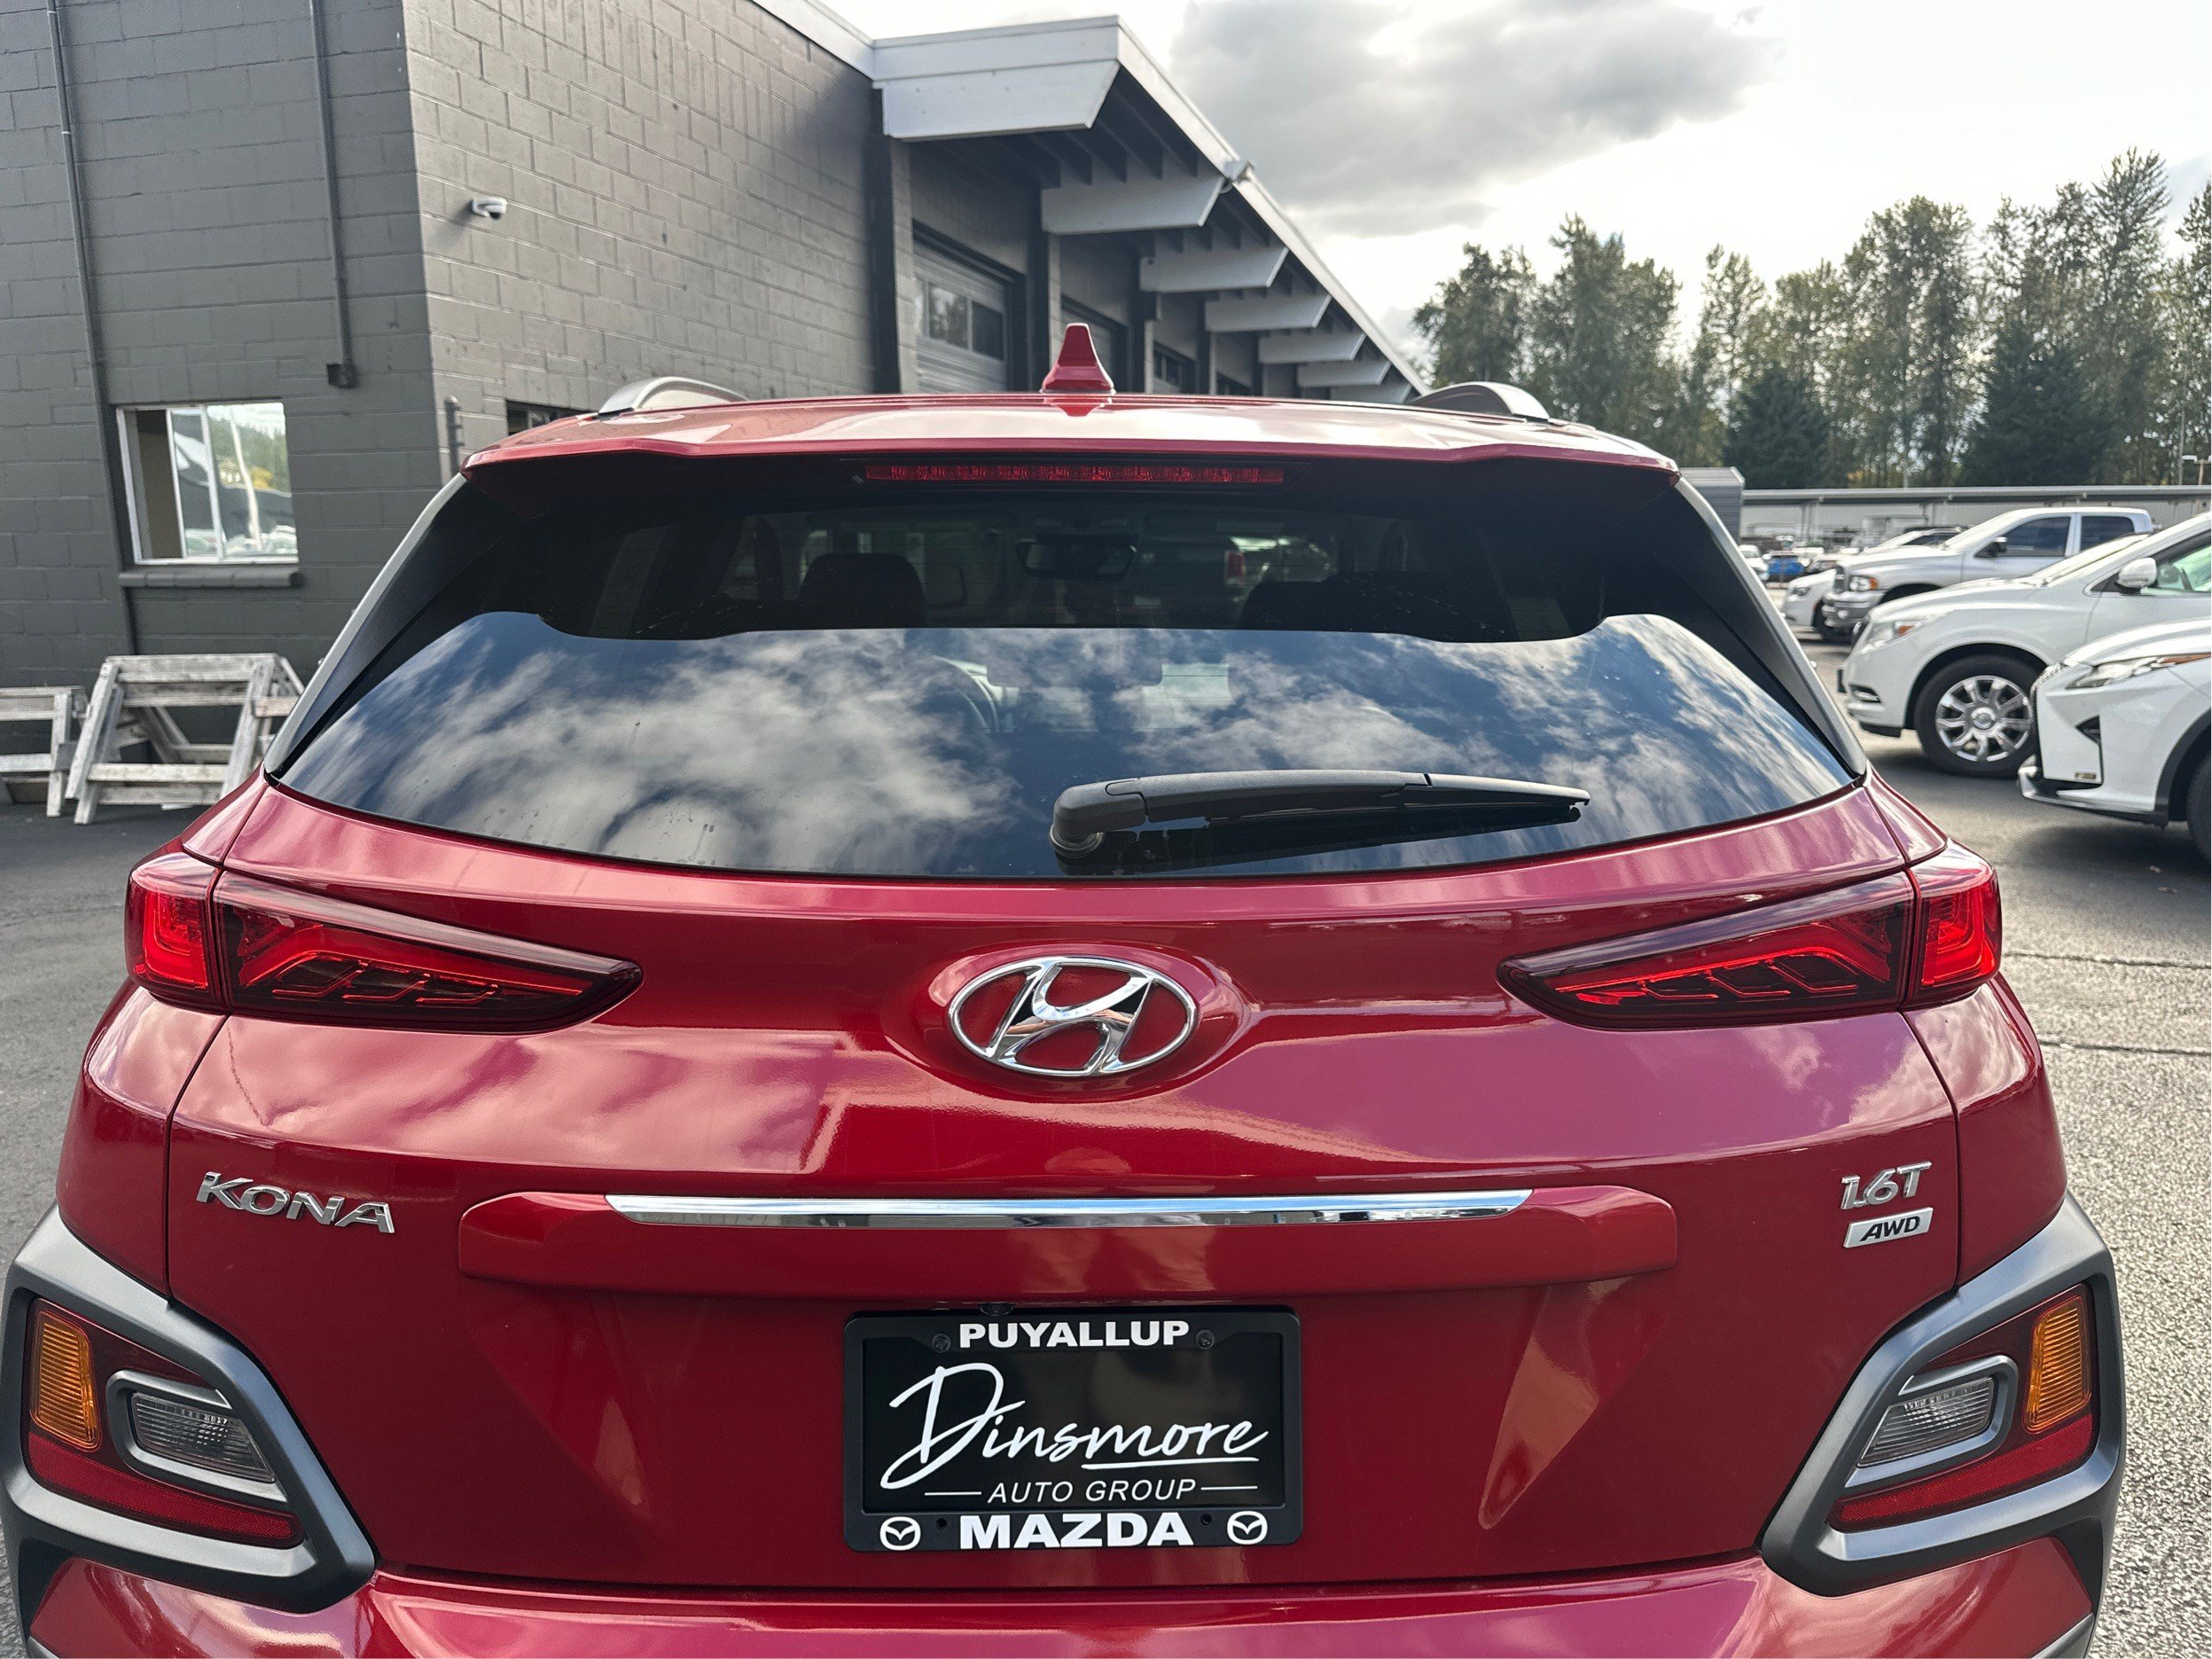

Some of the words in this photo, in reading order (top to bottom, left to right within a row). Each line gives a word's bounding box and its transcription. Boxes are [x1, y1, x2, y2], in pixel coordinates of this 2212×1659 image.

[196, 1170, 395, 1233] KONA
[1859, 1216, 1921, 1241] AWD
[958, 1320, 1191, 1349] PUYALLUP
[879, 1362, 1269, 1489] Dinsmore
[987, 1481, 1073, 1504] AUTO
[1084, 1478, 1197, 1502] GROUP
[959, 1511, 1194, 1550] MAZDA
